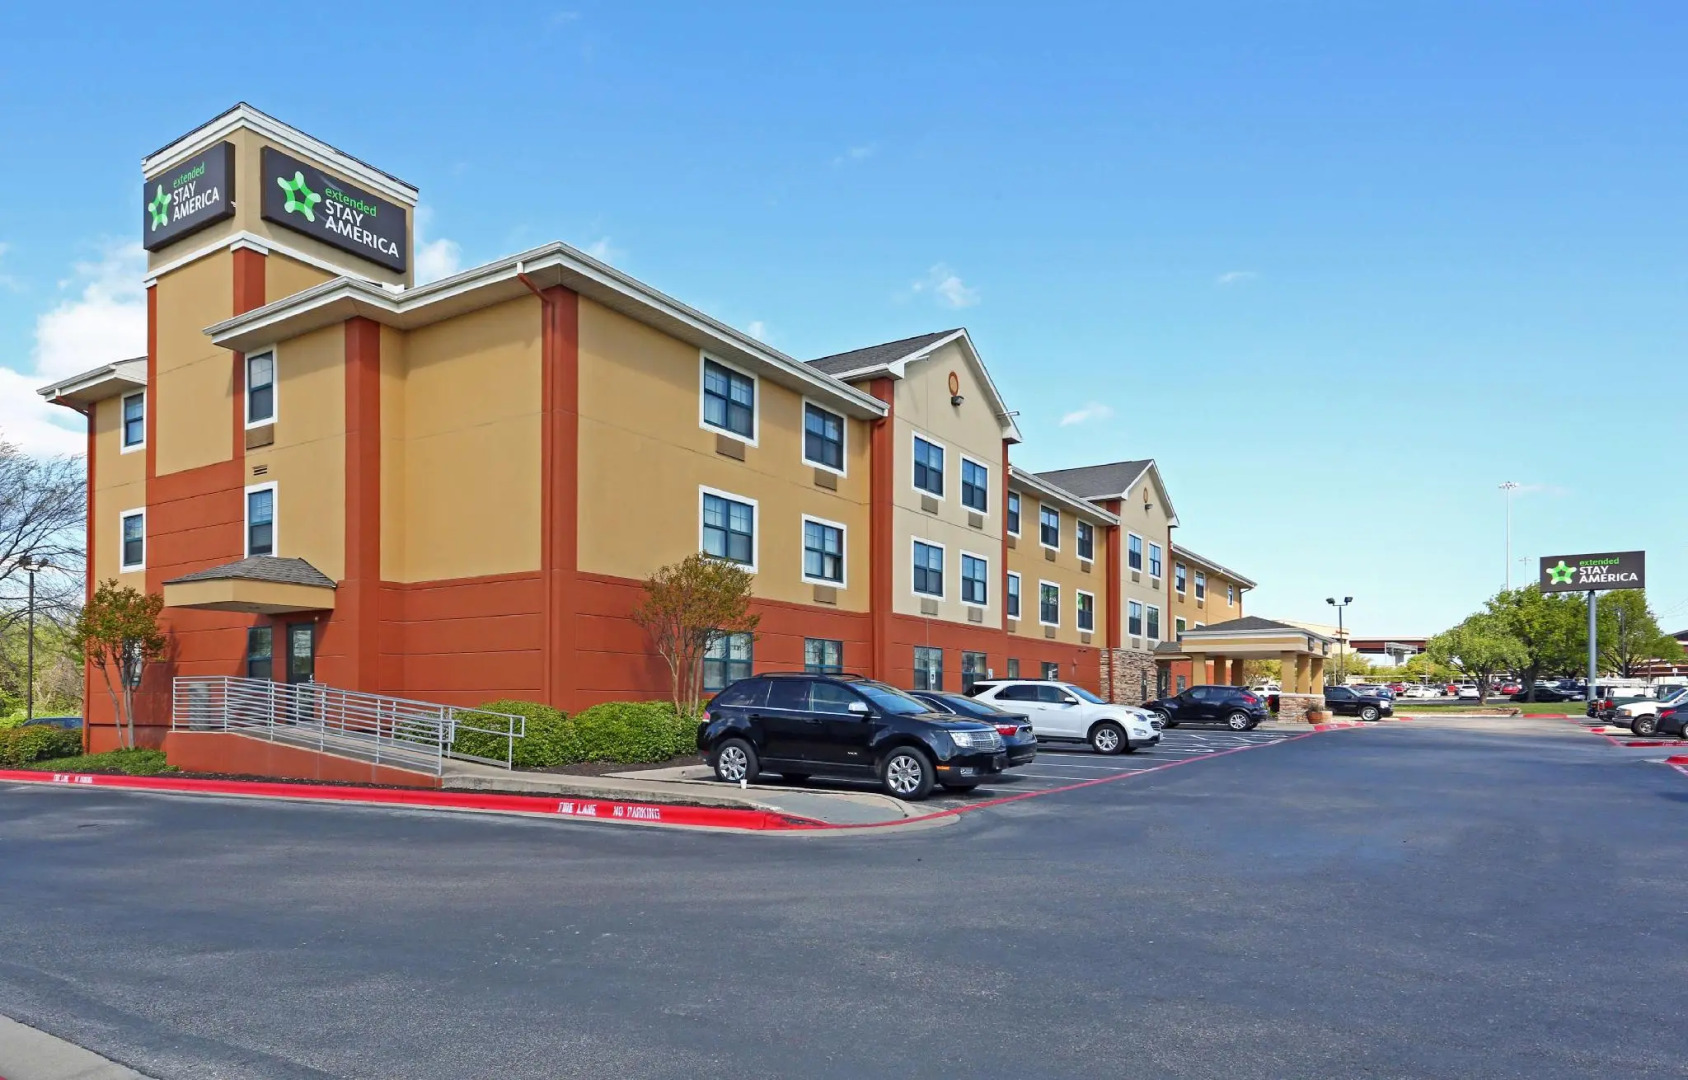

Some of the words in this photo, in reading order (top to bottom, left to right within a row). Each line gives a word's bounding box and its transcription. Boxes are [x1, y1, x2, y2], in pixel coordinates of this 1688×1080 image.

[173, 161, 205, 188] extended
[173, 181, 196, 205] STAY
[173, 186, 220, 222] AMERICA
[325, 187, 377, 217] extended
[325, 199, 364, 227] STAY
[325, 215, 400, 258] AMERICA
[1579, 558, 1619, 566] extended
[1579, 565, 1608, 575] STAY
[1579, 573, 1638, 583] AMERICA
[557, 802, 574, 814] FIRE
[576, 803, 596, 816] LANE
[613, 805, 624, 816] NO
[626, 806, 660, 819] PARKING
